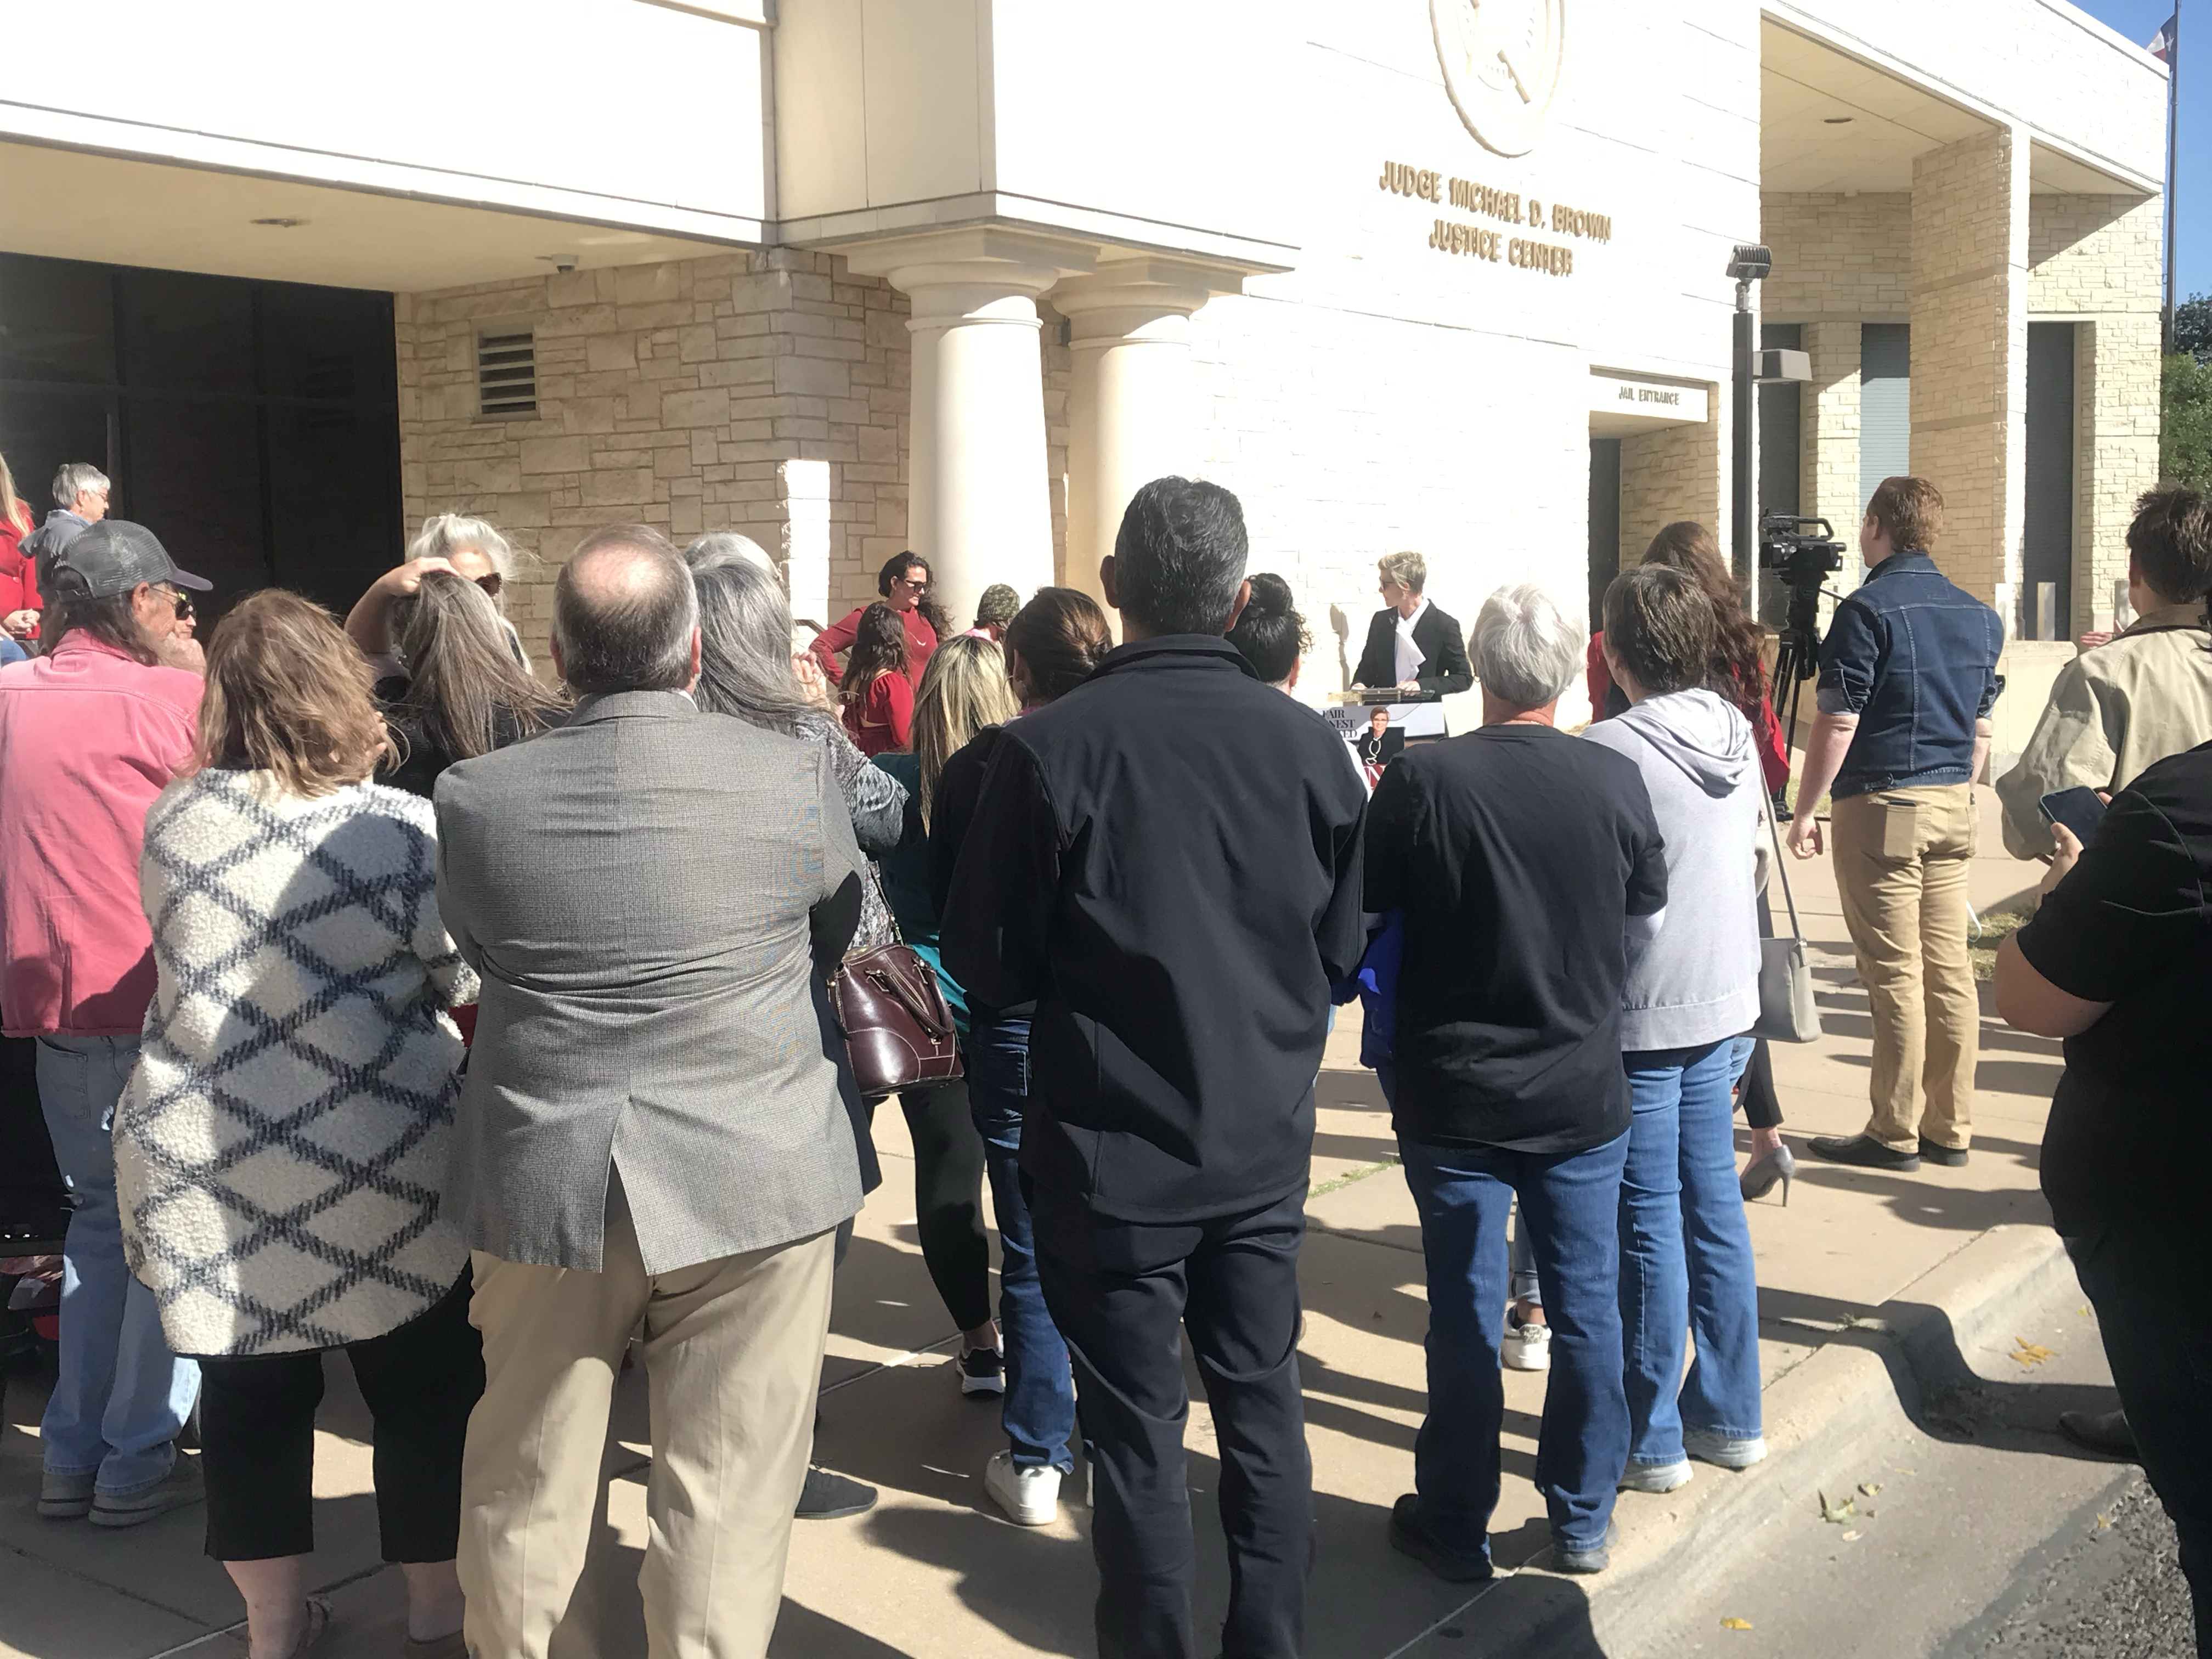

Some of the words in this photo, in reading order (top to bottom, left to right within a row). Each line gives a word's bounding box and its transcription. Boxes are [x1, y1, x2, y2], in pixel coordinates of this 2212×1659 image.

[1379, 160, 1443, 204] JUDGE
[1449, 177, 1526, 224] MICHAEL
[1529, 199, 1546, 229] D.
[1552, 204, 1611, 245] BROWN
[1429, 218, 1502, 263] JUSTICE
[1509, 237, 1573, 277] CENTER
[1619, 386, 1635, 400] JAIL
[1639, 388, 1679, 405] ENTRANCE
[1323, 709, 1345, 718] FAIR
[1329, 719, 1355, 729] NEST
